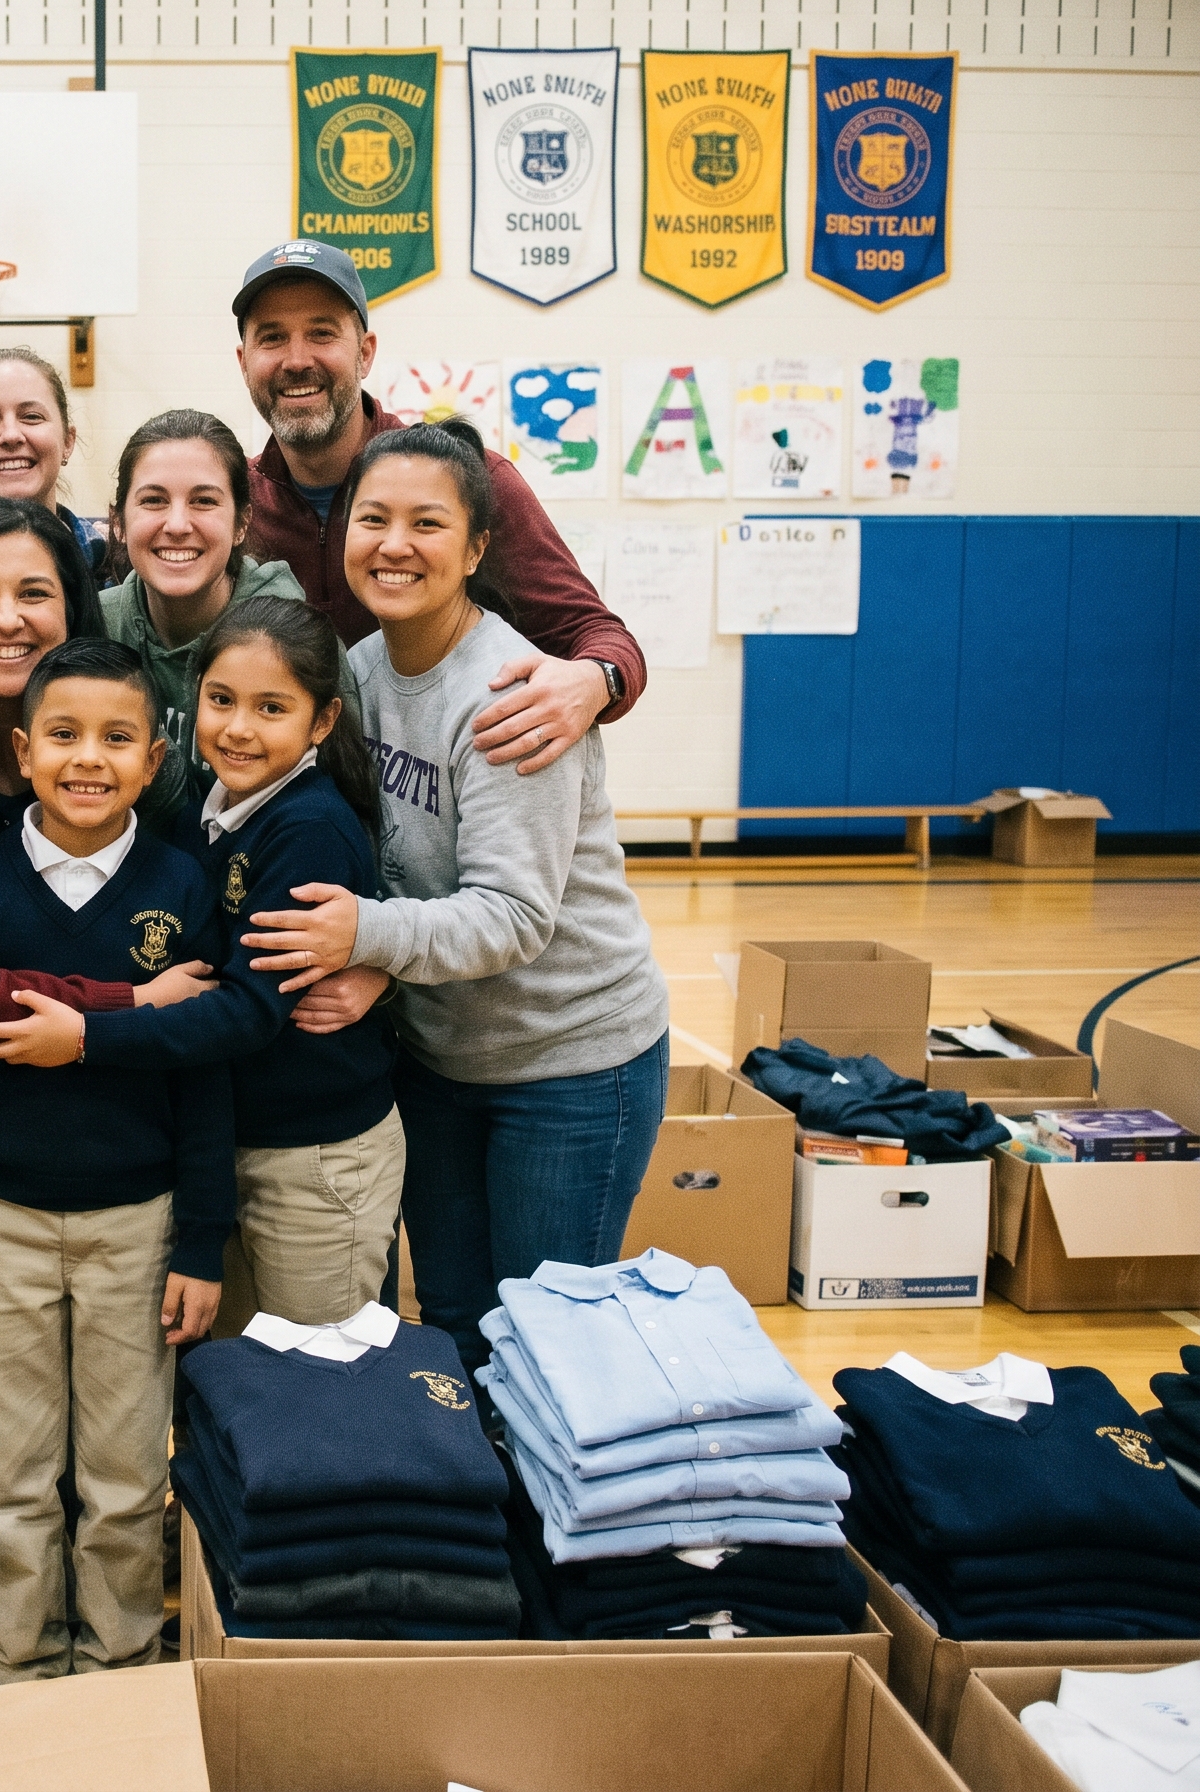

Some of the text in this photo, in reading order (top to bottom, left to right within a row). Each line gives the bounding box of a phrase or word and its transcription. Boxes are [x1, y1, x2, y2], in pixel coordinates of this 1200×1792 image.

[506, 211, 583, 232] SCHOOL
[520, 246, 571, 266] 1989
[690, 249, 738, 269] 1992
[855, 249, 906, 272] 1909
[624, 366, 725, 477] A
